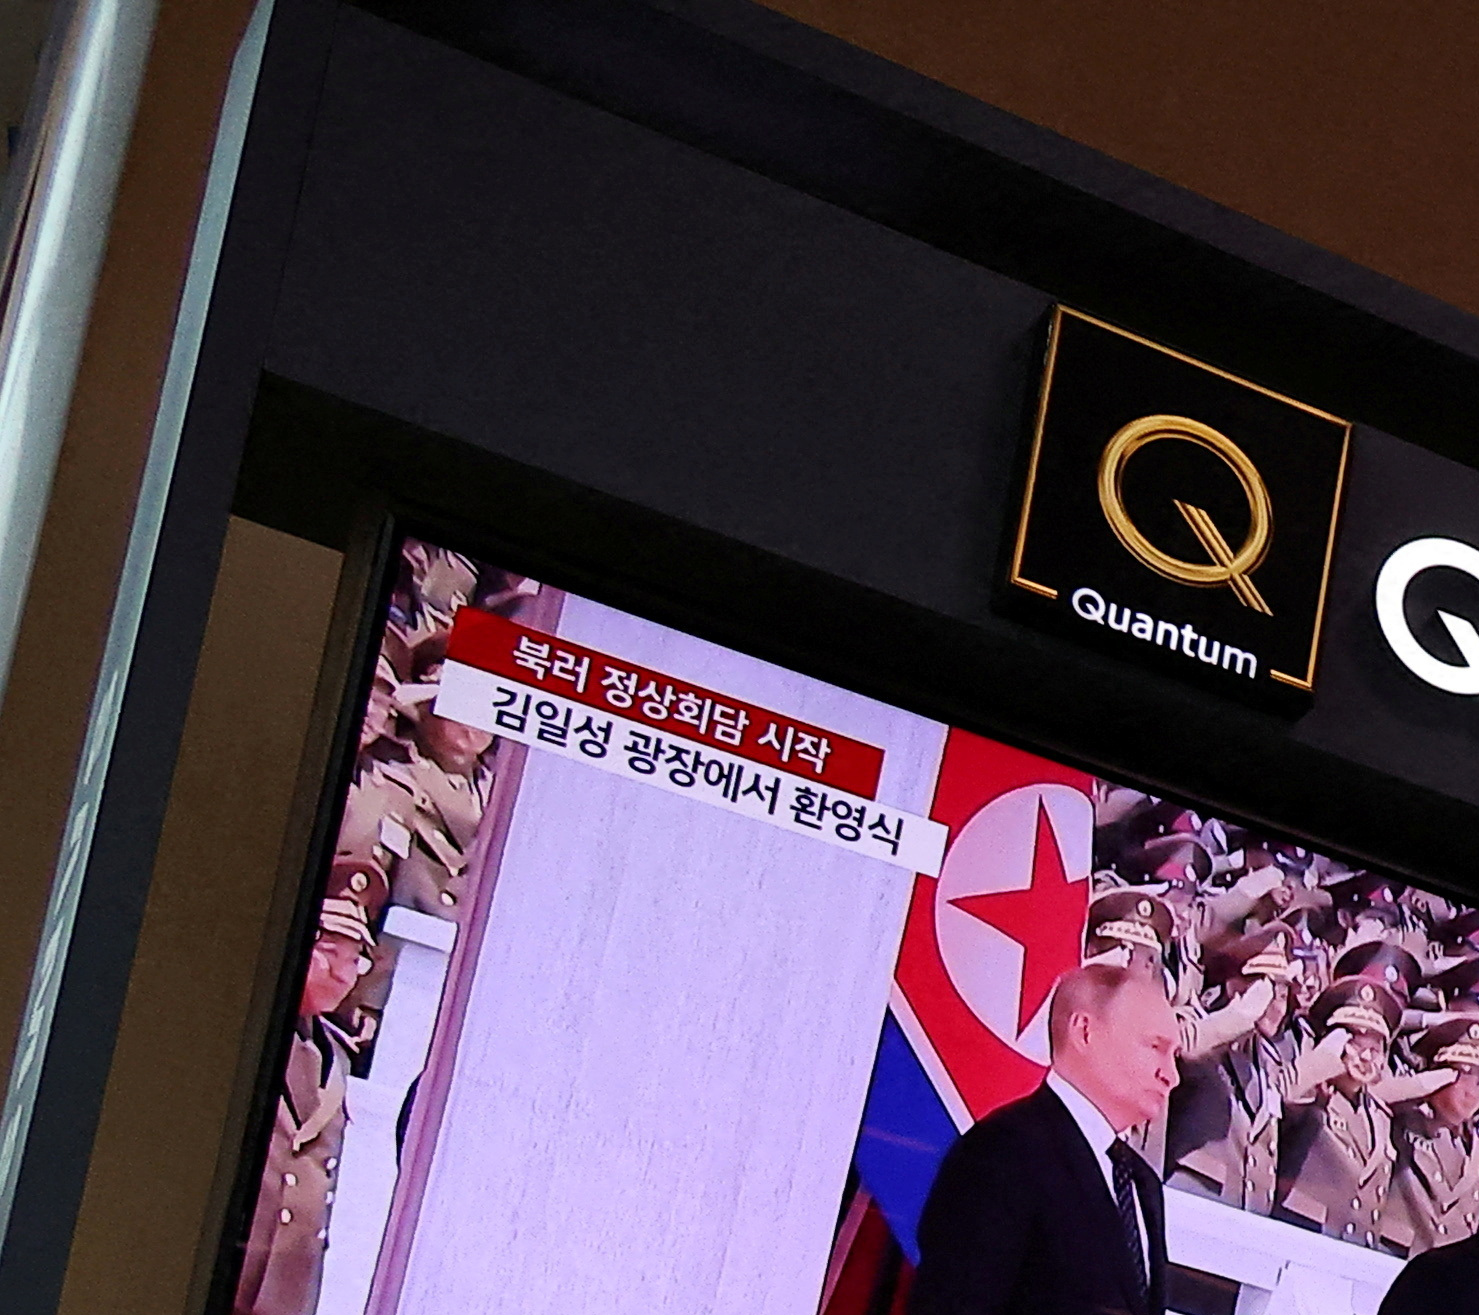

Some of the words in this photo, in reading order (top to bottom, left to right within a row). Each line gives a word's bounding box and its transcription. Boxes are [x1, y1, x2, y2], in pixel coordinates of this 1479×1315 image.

[1096, 413, 1274, 617] Q
[511, 634, 590, 698] 북러
[600, 661, 752, 748] 정상회담
[758, 715, 832, 776] 시작
[1071, 587, 1259, 679] Quantum
[490, 686, 612, 760] 김일성
[623, 729, 783, 815] 광장에서
[789, 780, 906, 856] 환영식
